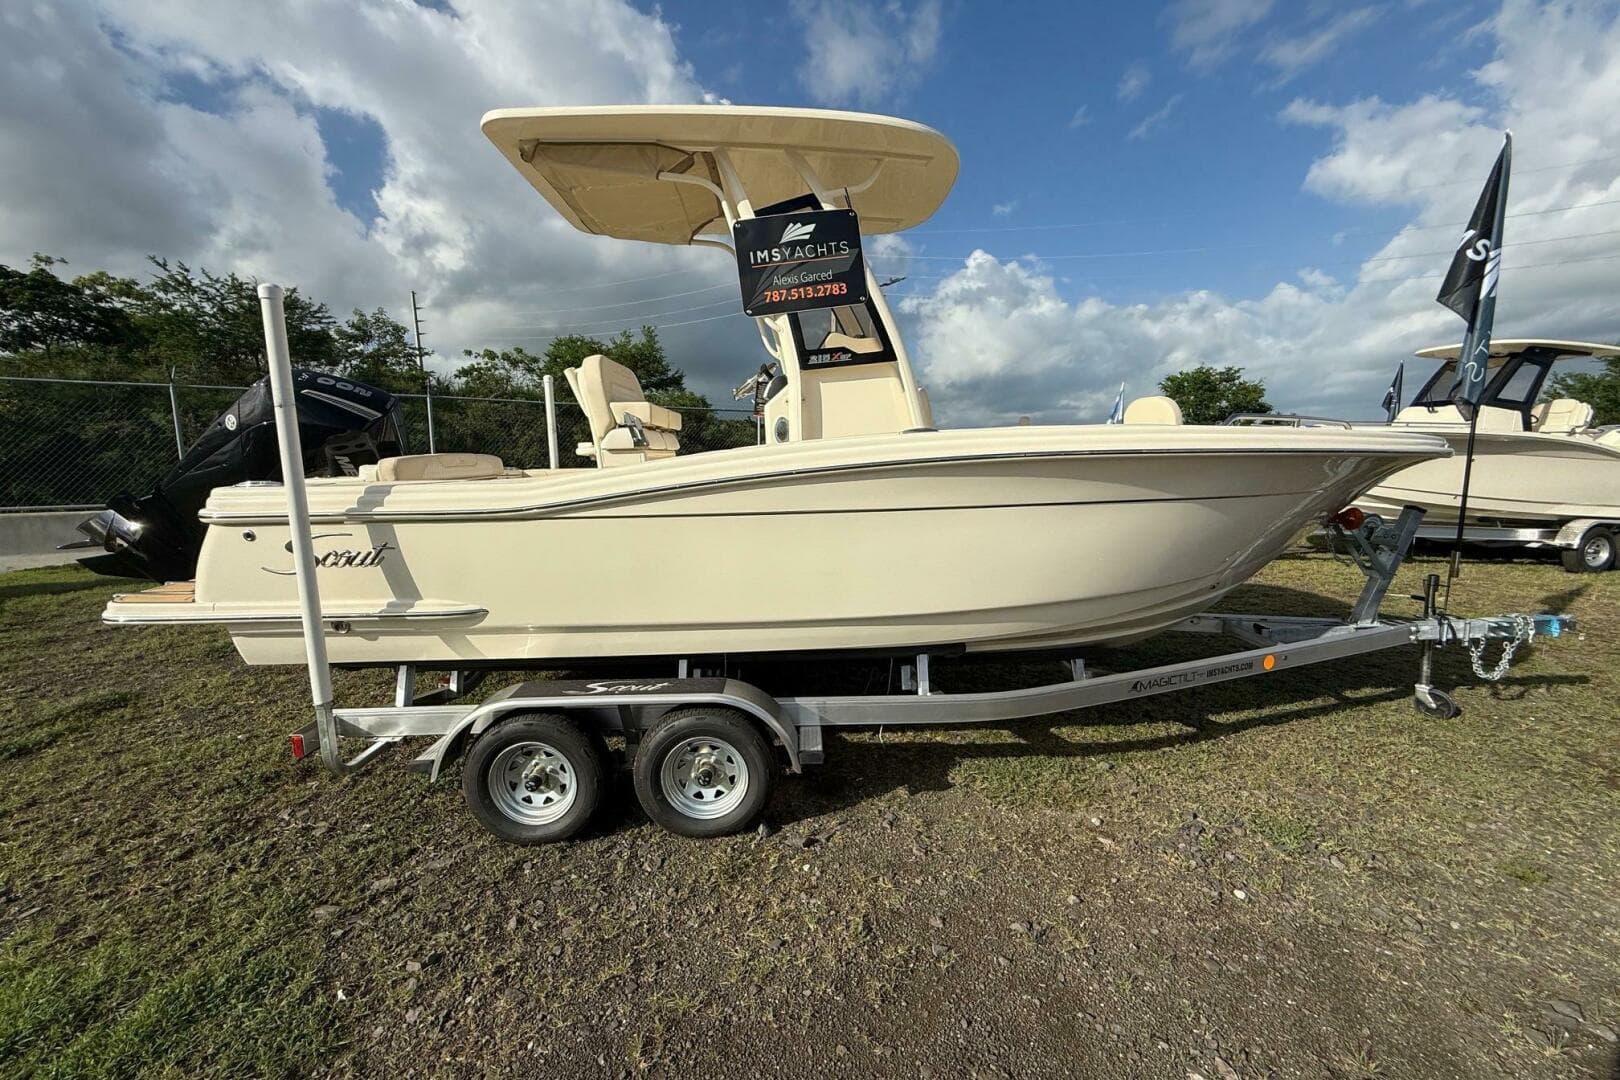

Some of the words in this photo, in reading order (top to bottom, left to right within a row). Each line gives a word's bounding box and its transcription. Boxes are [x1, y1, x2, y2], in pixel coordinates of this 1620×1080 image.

[773, 273, 799, 286] Alexis
[800, 269, 833, 282] Garced
[764, 283, 847, 302] 787.513.2783
